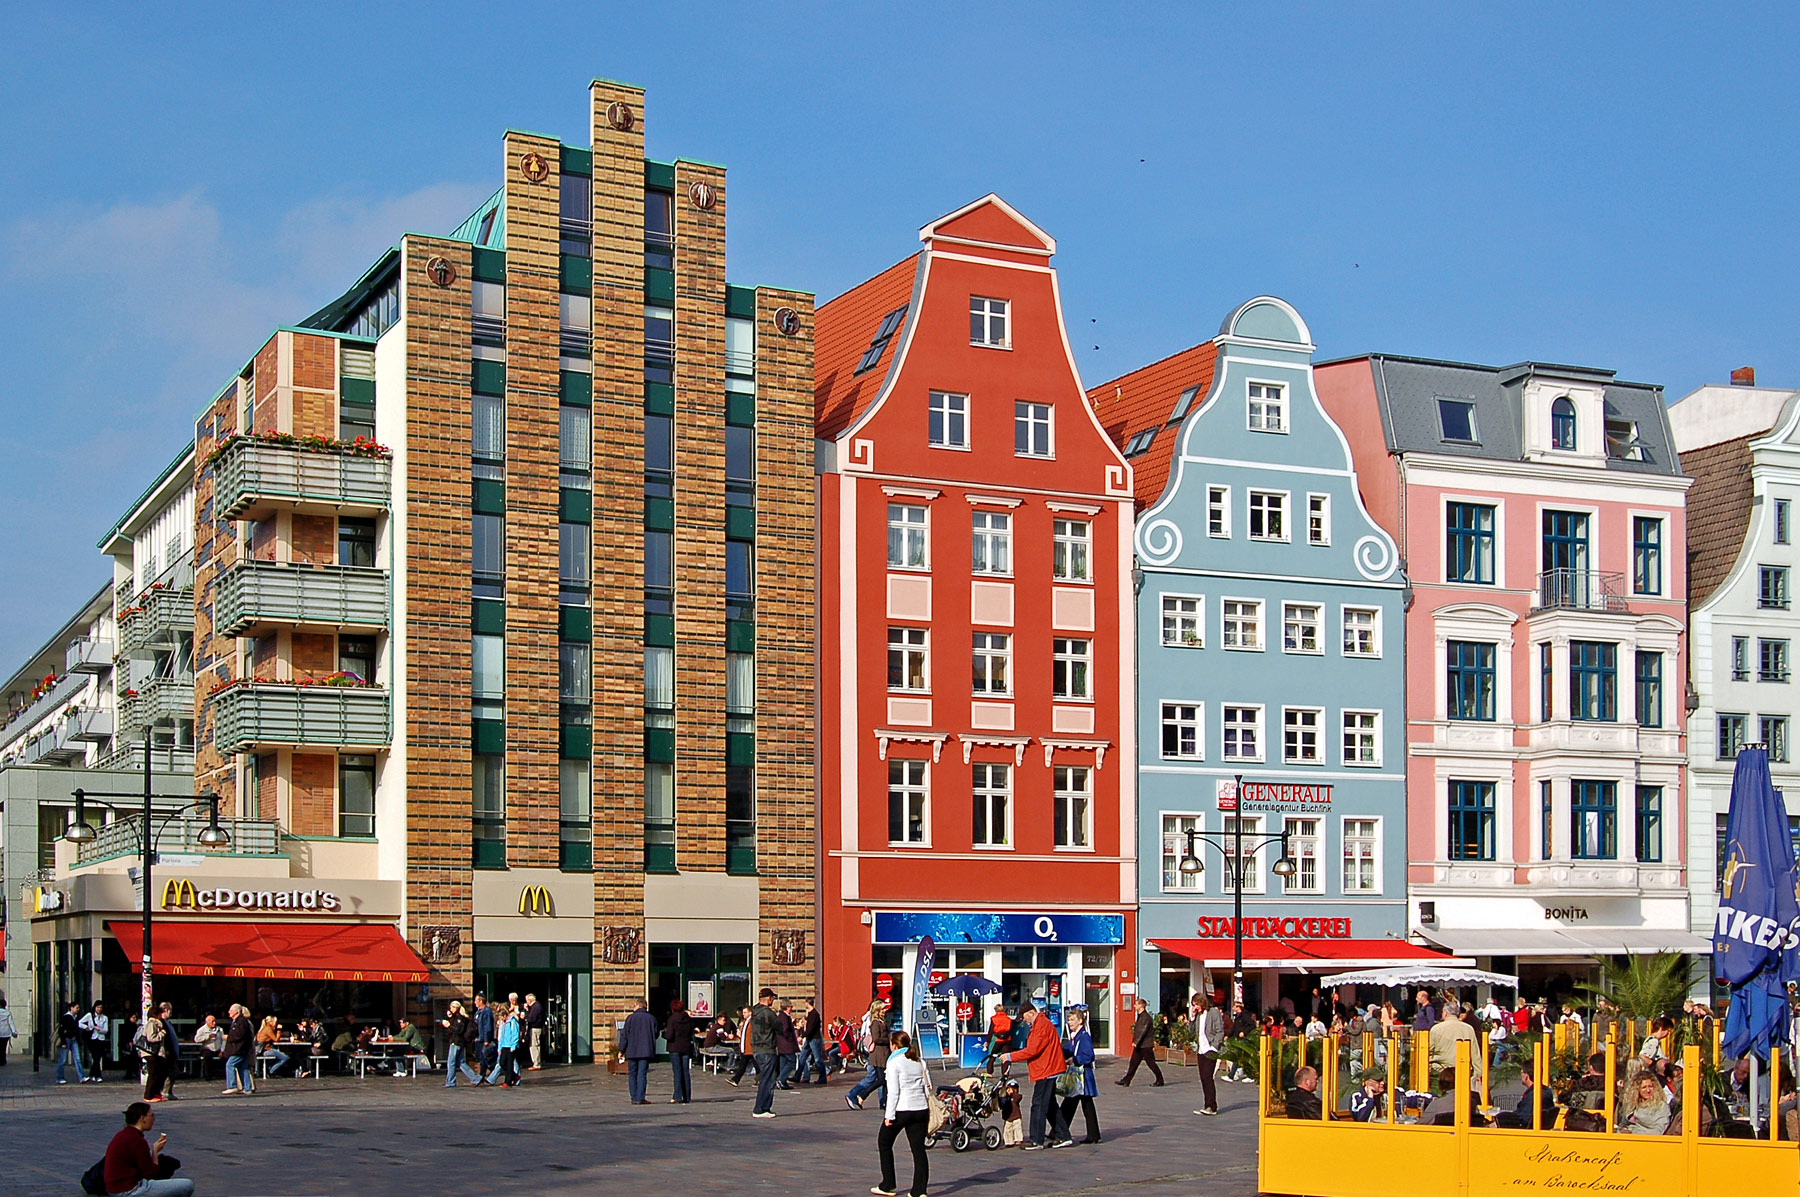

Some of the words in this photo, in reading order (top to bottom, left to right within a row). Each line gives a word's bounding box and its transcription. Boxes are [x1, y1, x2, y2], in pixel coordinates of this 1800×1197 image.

[1242, 783, 1332, 804] GENERALI
[1242, 802, 1299, 813] Generalagentur
[1300, 803, 1332, 813] Buchfink
[161, 878, 337, 908] McDonald's
[920, 949, 934, 979] DSL
